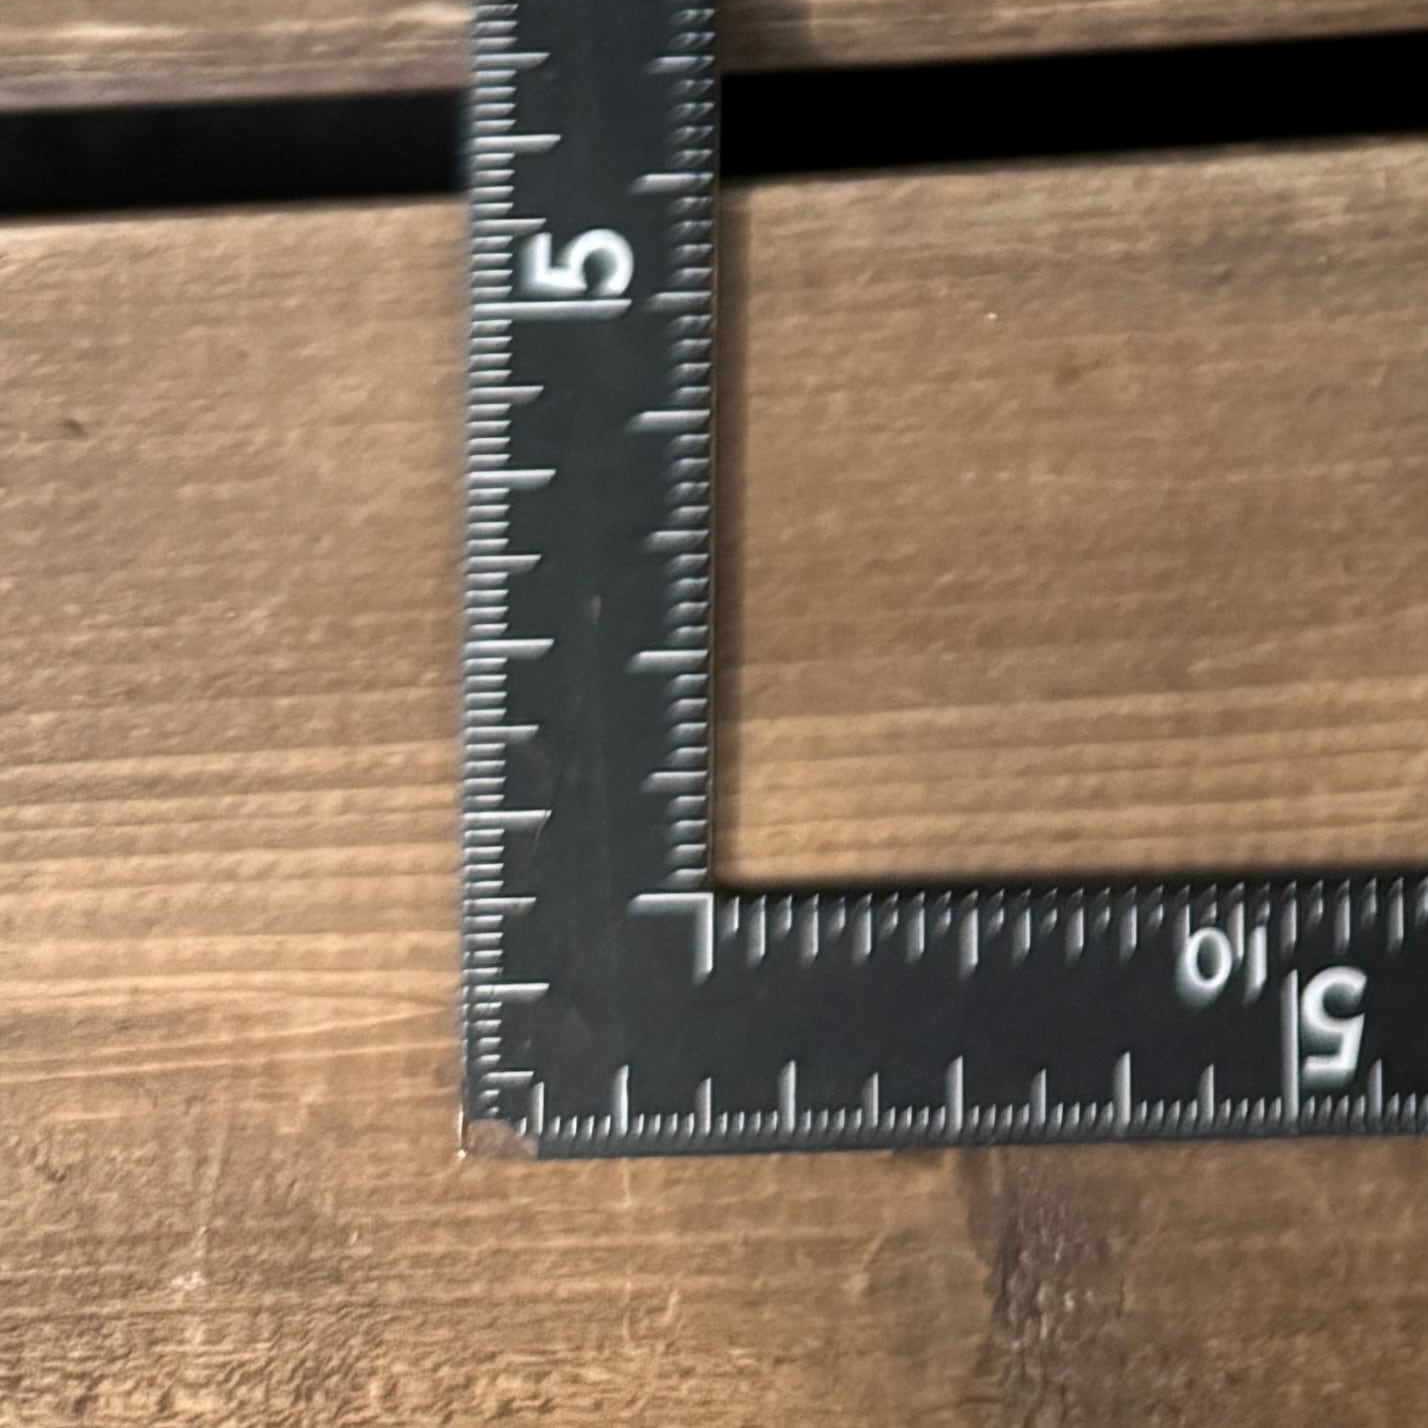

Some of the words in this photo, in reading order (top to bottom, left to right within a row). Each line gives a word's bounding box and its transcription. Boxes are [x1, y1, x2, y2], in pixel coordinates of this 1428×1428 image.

[522, 227, 636, 297] 5
[1182, 926, 1268, 996] 10
[1301, 965, 1368, 1077] 5
